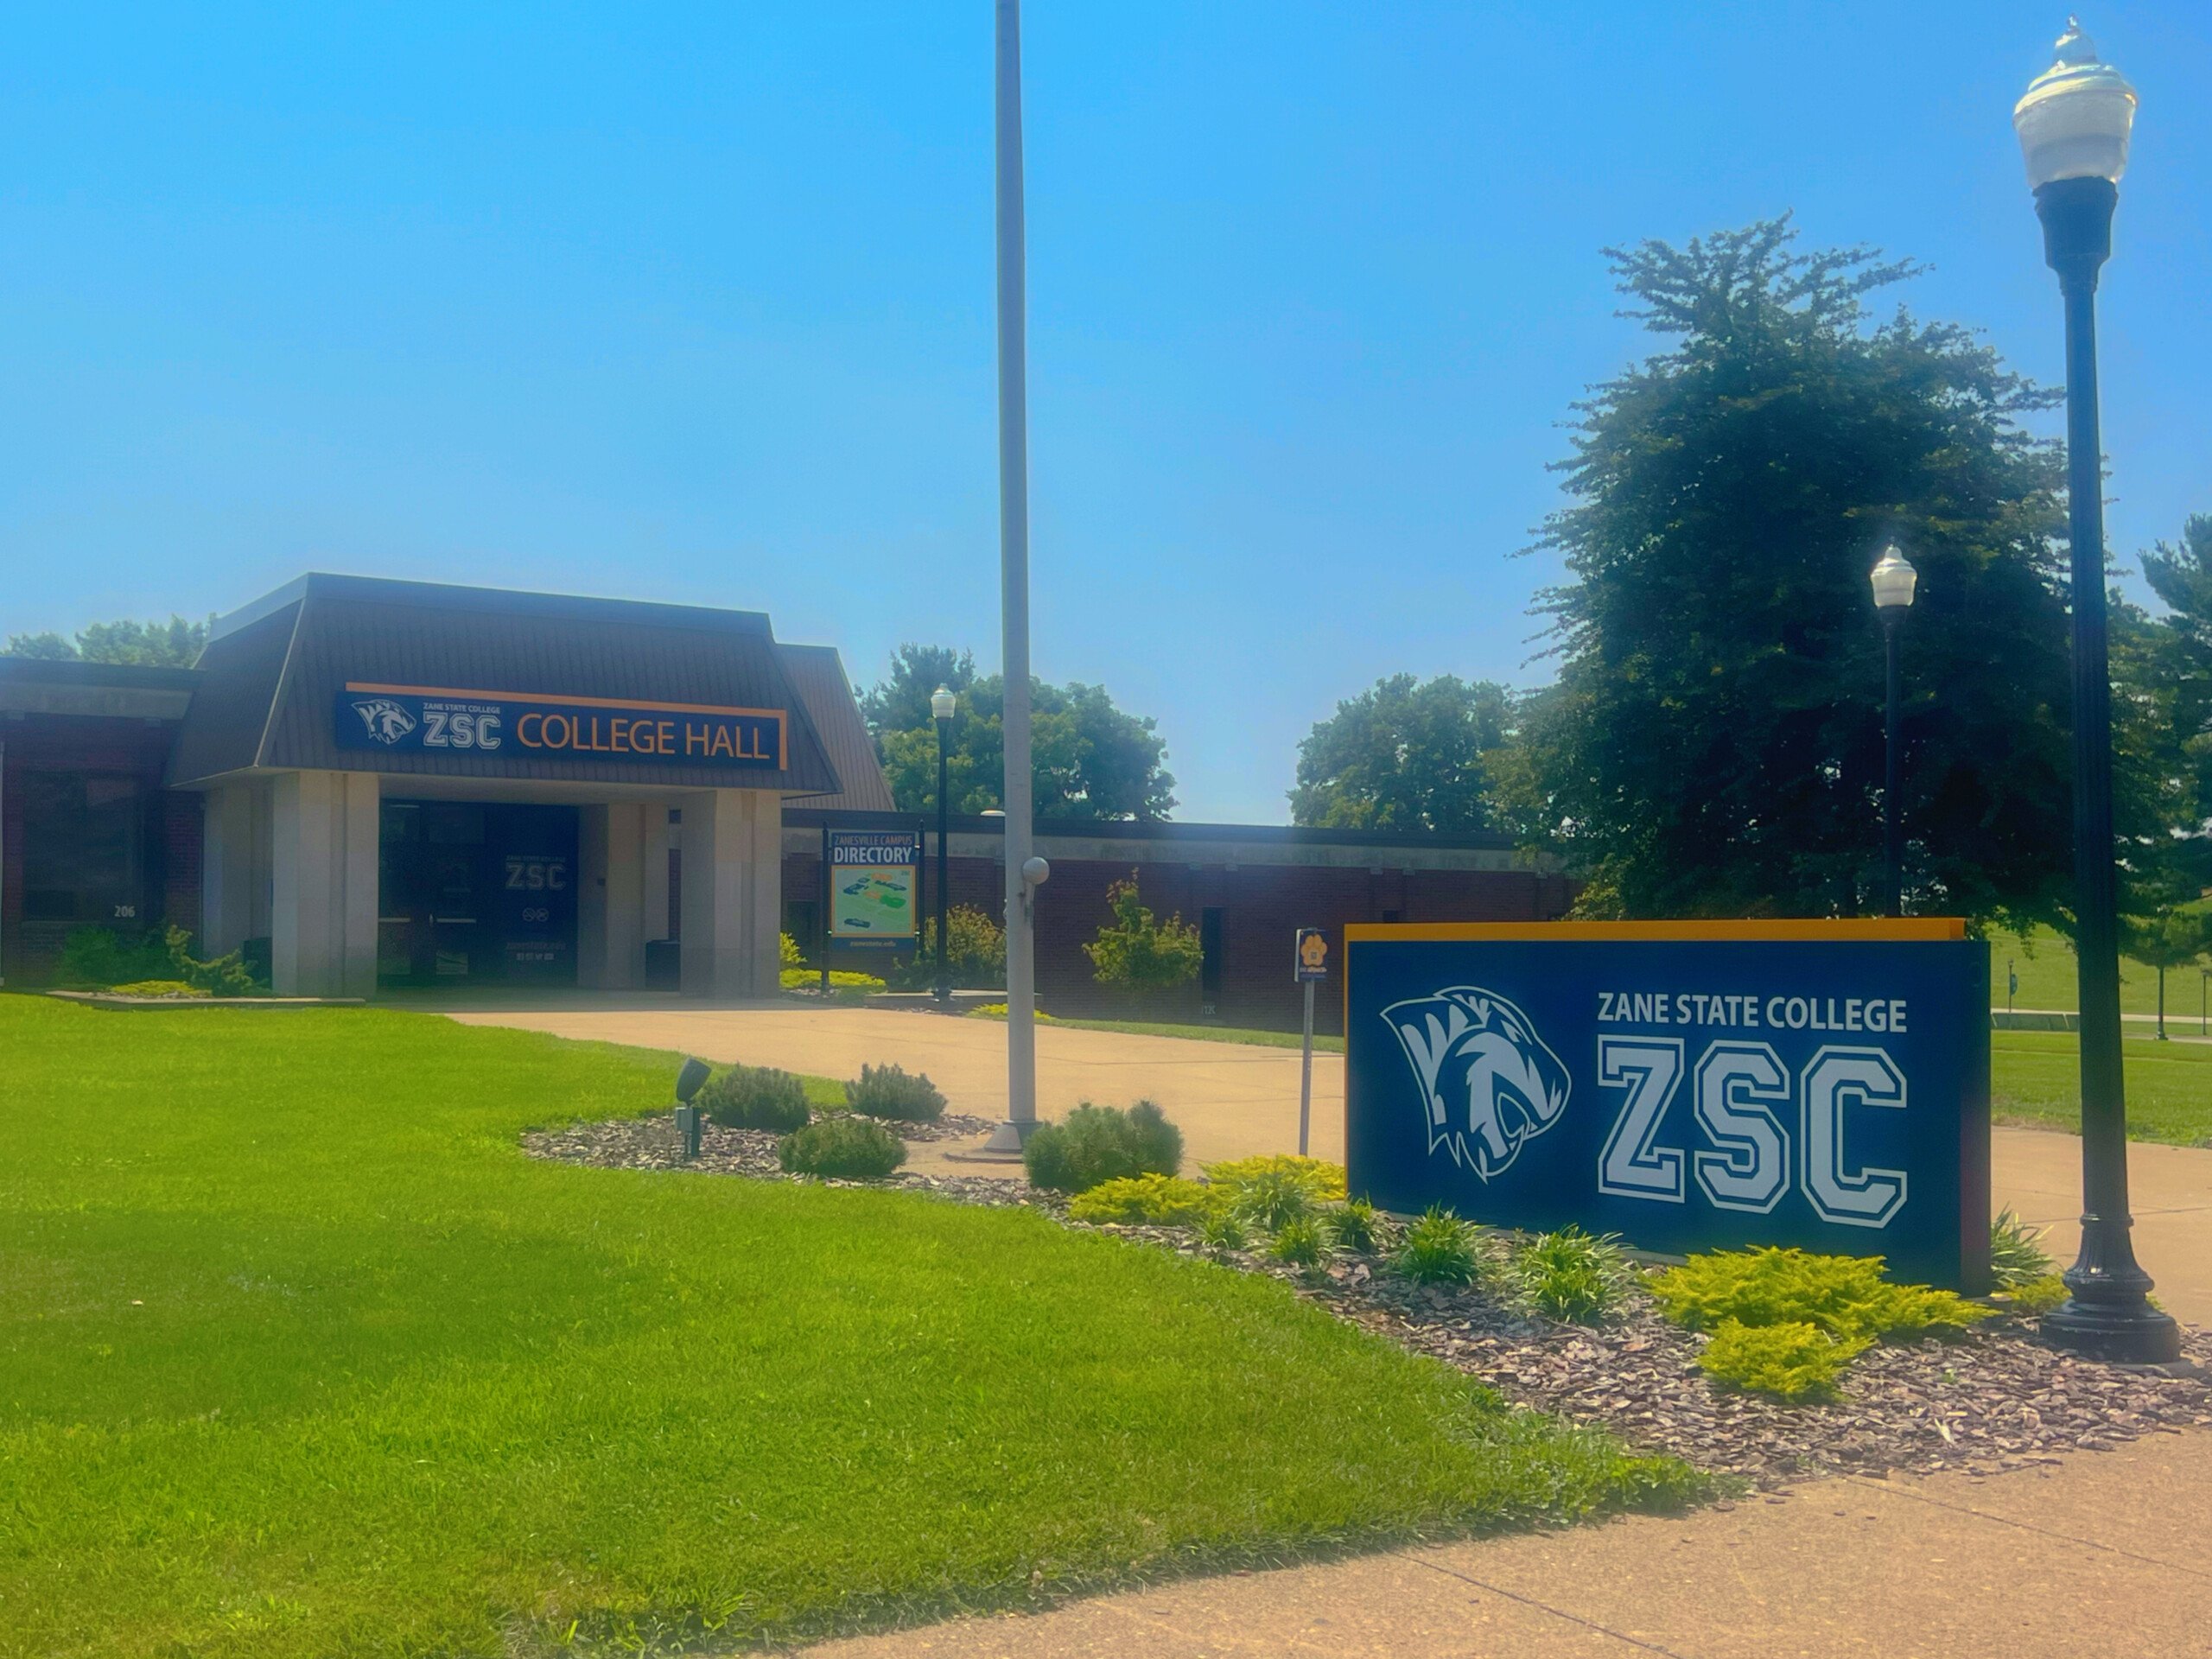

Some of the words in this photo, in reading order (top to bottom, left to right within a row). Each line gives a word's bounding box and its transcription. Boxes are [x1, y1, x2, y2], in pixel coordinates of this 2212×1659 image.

[423, 702, 444, 711] ZANE
[445, 703, 467, 712] STATE
[467, 705, 500, 715] COLLEGE
[423, 711, 501, 750] ZSC
[517, 713, 675, 755] COLLEGE
[686, 724, 770, 760] HALL
[833, 847, 912, 863] DIRECTORY
[834, 835, 878, 846] ZANESVILLE
[880, 836, 912, 846] CAMPUS
[505, 861, 566, 891] ZSC
[114, 906, 136, 918] 206
[1597, 991, 1669, 1026] ZANE
[1676, 994, 1759, 1027] STATE
[1766, 996, 1908, 1034] COLLEGE
[1597, 1034, 1909, 1230] ZSC
